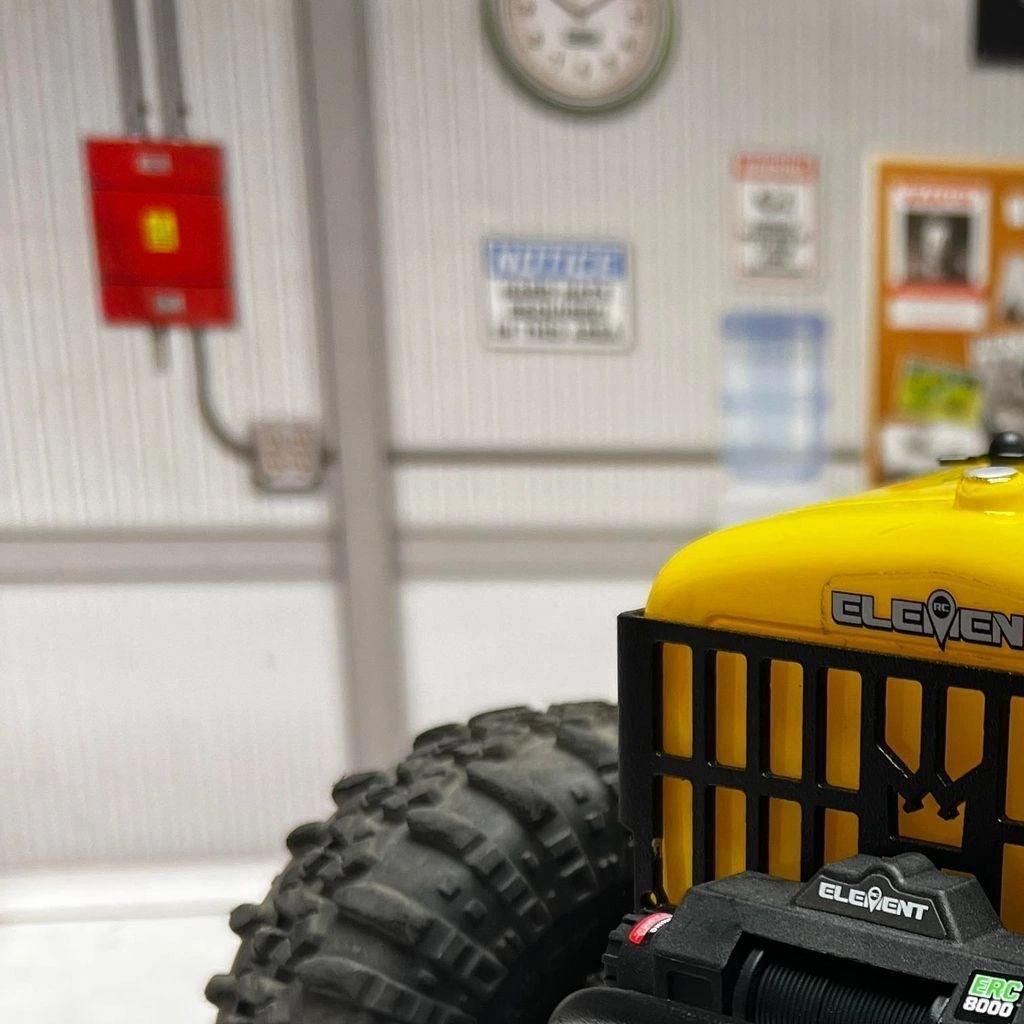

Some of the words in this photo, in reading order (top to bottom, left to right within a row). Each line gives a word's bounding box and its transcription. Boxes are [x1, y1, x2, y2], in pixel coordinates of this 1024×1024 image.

[933, 602, 950, 613] RC
[818, 881, 930, 921] ELEMENT
[968, 974, 1024, 1003] ERC
[963, 996, 1014, 1018] 8000
